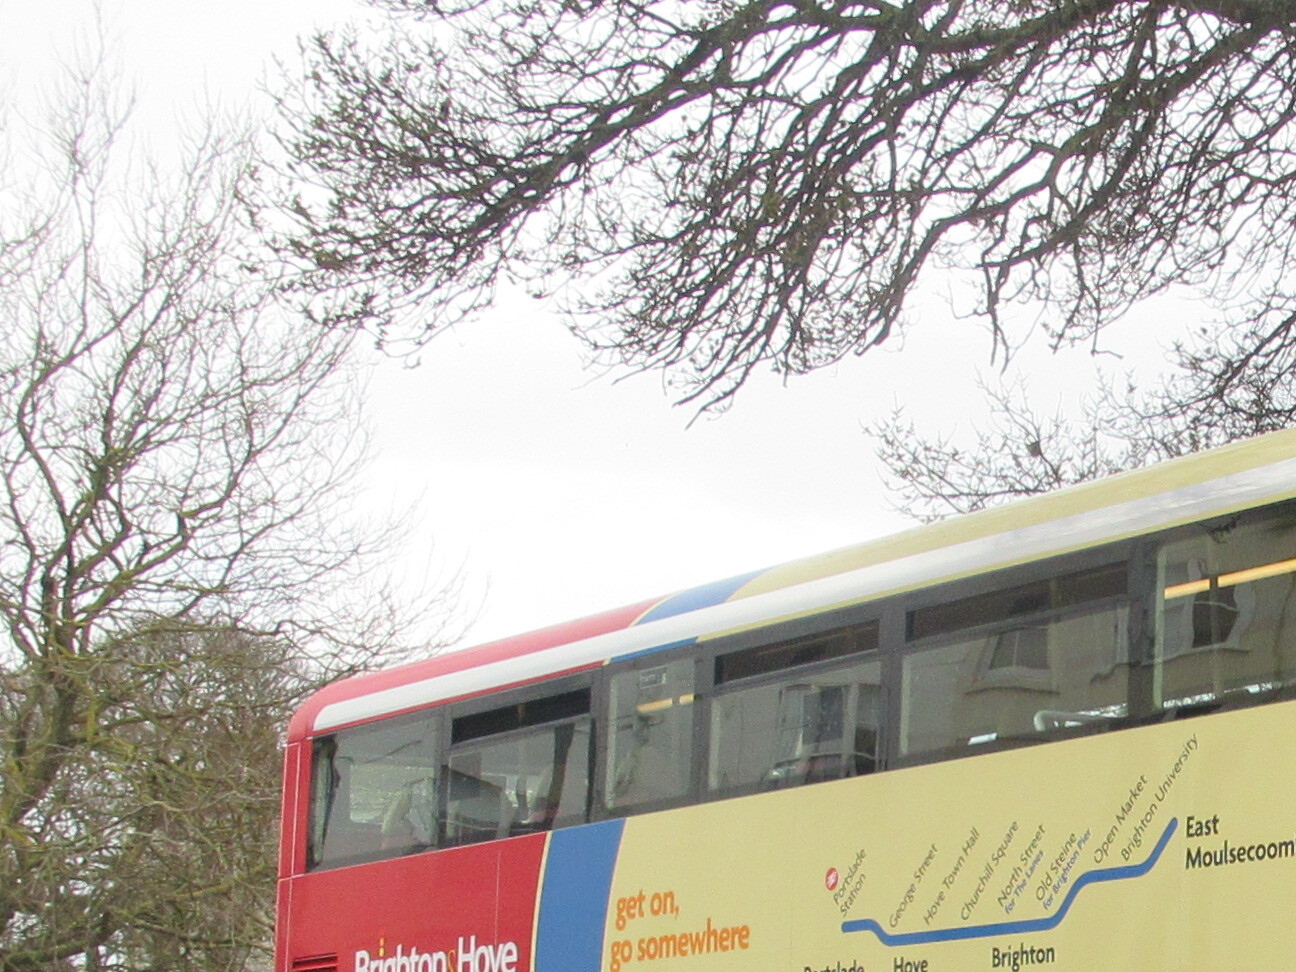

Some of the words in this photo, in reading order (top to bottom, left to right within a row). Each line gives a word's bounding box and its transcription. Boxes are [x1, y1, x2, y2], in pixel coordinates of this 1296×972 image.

[1094, 825, 1119, 863] Open
[1116, 774, 1148, 826] Market
[1121, 803, 1158, 861] Brighton
[1154, 733, 1199, 802] University
[1186, 815, 1219, 838] East
[833, 849, 867, 905] Portslade
[889, 883, 916, 928] George
[913, 843, 938, 883] Street
[923, 891, 946, 925] Hove
[942, 856, 965, 890] Town
[962, 827, 979, 856] Hall
[961, 863, 994, 920] Churchill
[991, 822, 1019, 866] Square
[997, 867, 1022, 907] North
[1020, 824, 1046, 866] Street
[1036, 872, 1053, 900] Old
[1052, 850, 1080, 895] Brighton
[616, 891, 646, 931] get
[650, 890, 680, 918] on,
[637, 918, 751, 962] somewhere
[992, 943, 1055, 972] Brighton
